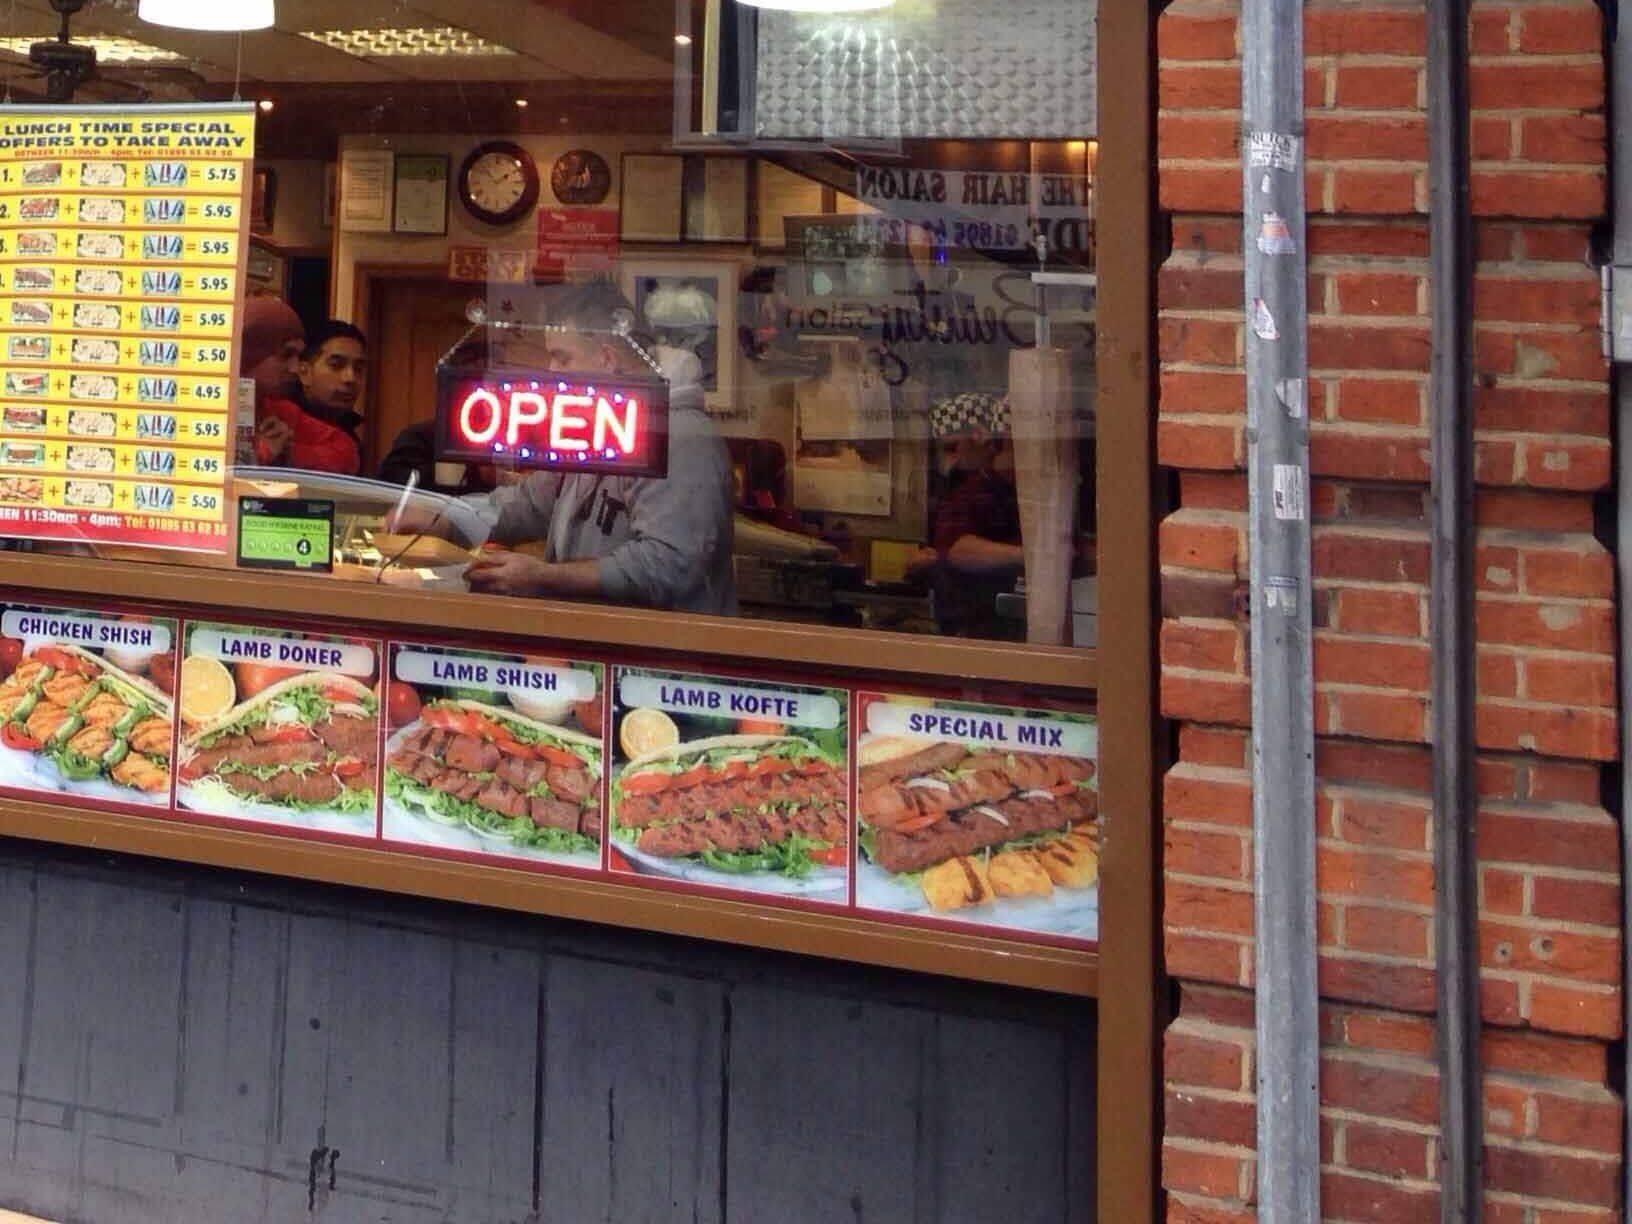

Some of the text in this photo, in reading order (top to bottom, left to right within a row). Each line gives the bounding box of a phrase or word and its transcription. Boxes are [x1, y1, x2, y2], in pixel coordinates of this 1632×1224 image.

[4, 122, 235, 136] LUNCH TIME SPECIAL
[80, 136, 108, 147] TO
[114, 136, 170, 147] TAKE
[178, 136, 245, 147] AWAY
[2, 167, 236, 183] 1. 5.75
[0, 204, 232, 218] 2. 5.95
[202, 241, 229, 254] 5.95
[200, 277, 228, 290] 5.95
[199, 313, 226, 326] 5.95
[197, 349, 226, 362] 5.50
[195, 385, 221, 399] 4.95
[459, 390, 638, 454] OPEN
[195, 423, 220, 436] 5.95
[193, 459, 218, 472] 4.95
[191, 495, 216, 509] 5.50
[24, 509, 78, 524] 11:30am
[125, 516, 145, 528] Tel:
[298, 540, 309, 553] 4
[18, 616, 153, 647] CHICKEN SHISH
[221, 637, 343, 667] LAMB DONER
[432, 660, 558, 692] LAMB SHISH
[659, 686, 799, 719] LAMB KOFTE
[909, 711, 1064, 749] SPECIAL MIX
